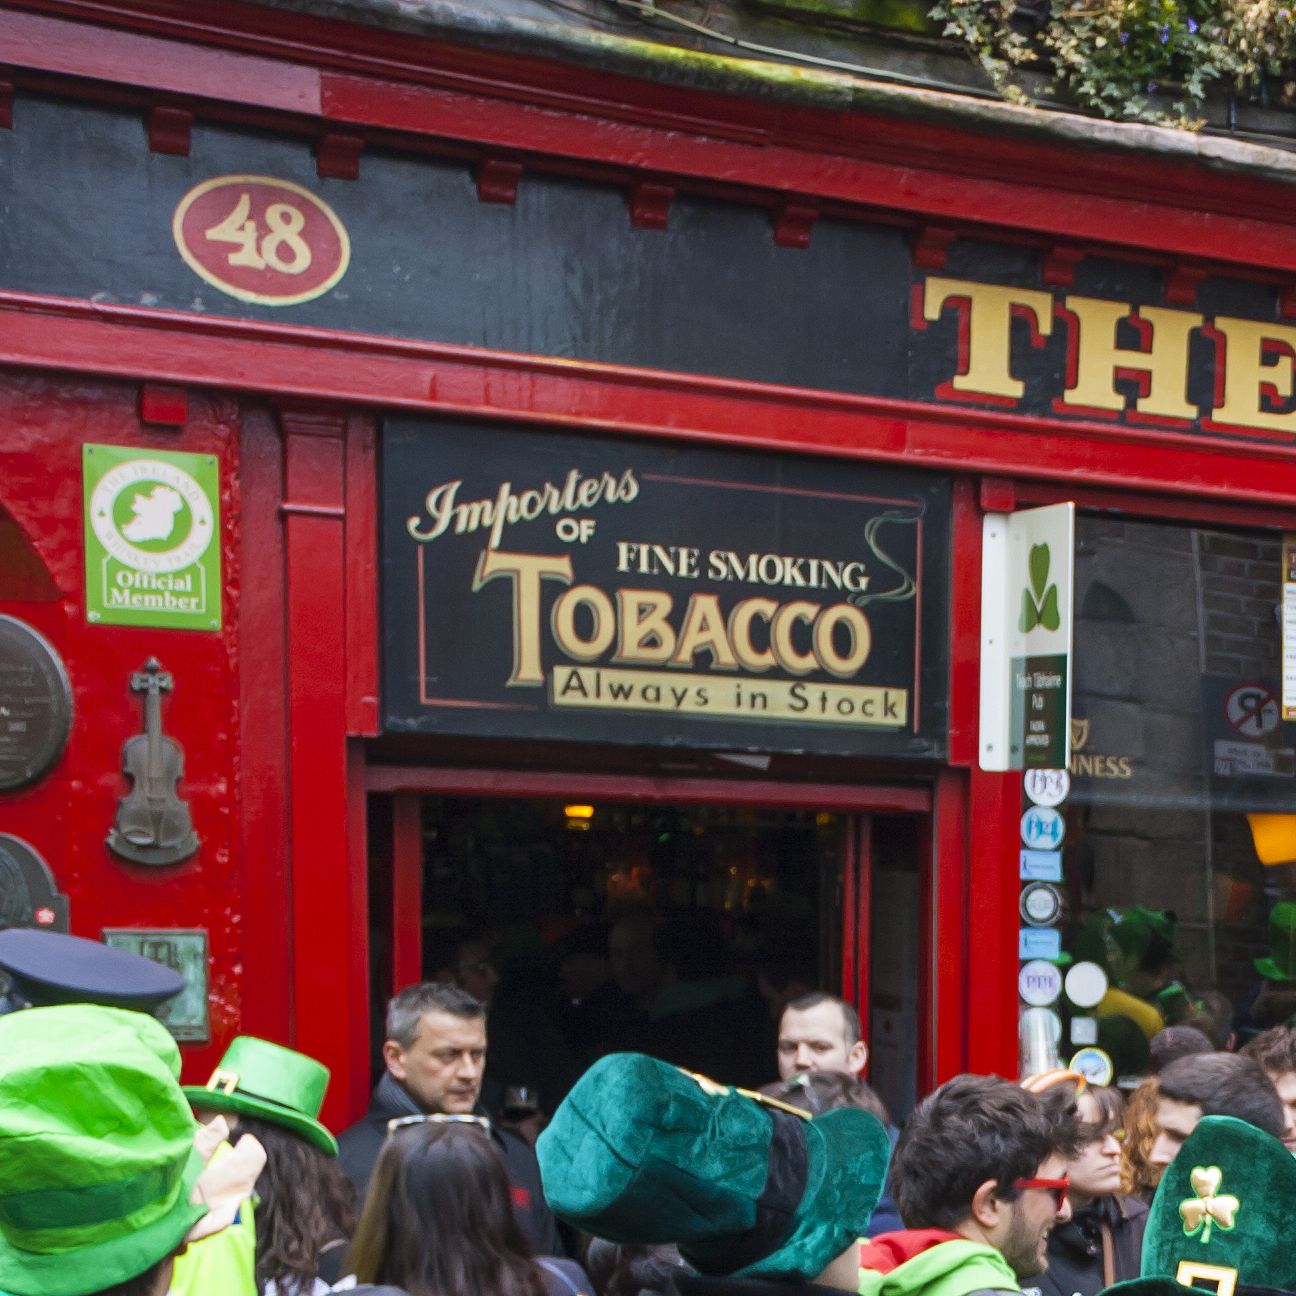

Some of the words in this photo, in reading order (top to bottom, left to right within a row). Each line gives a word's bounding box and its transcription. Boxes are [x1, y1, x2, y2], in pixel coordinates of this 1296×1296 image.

[205, 193, 312, 275] 48
[407, 468, 640, 549] Importers
[556, 518, 595, 543] OF
[116, 569, 192, 592] Official
[616, 542, 700, 579] FINE
[708, 551, 871, 592] SMOKING
[110, 587, 199, 610] Member
[473, 549, 872, 687] TOBACCO
[560, 668, 709, 709] Always
[735, 683, 769, 710] in
[788, 682, 899, 719] Stock
